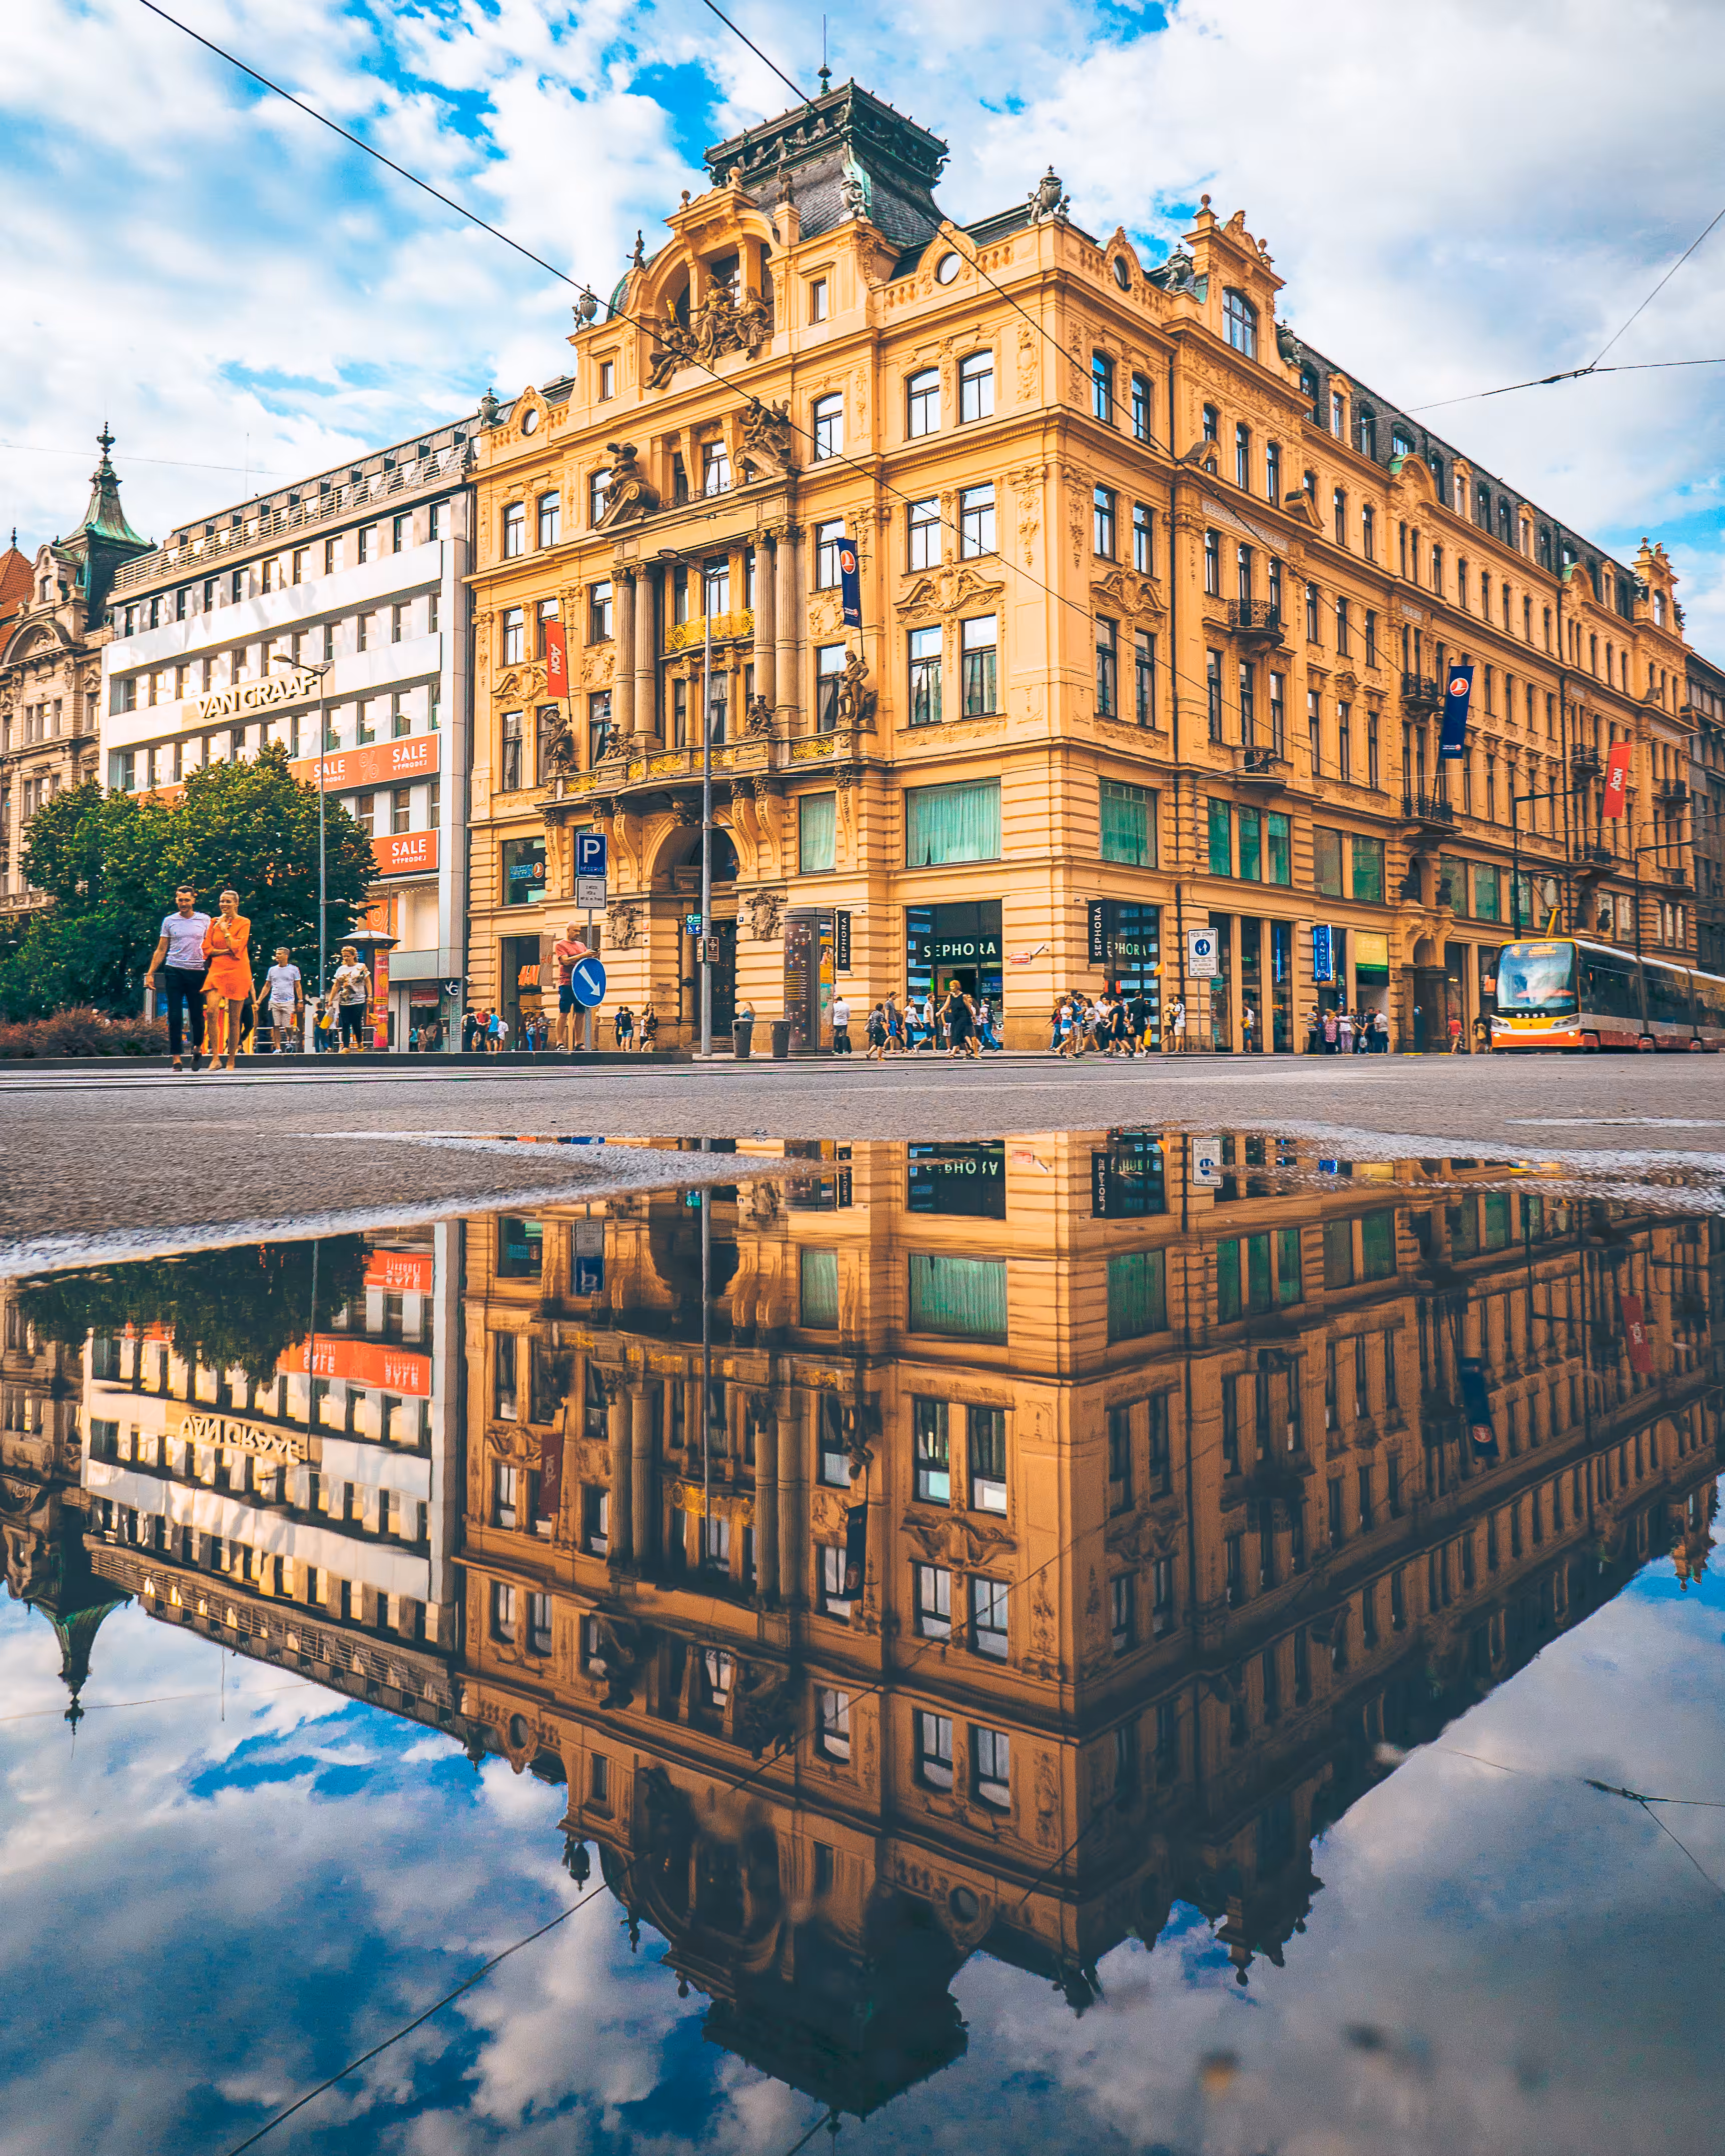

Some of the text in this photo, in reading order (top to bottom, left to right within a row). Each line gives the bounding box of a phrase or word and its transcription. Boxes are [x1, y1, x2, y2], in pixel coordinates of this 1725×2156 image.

[196, 670, 316, 718] VAN GRAAF
[392, 743, 427, 763] SALE
[314, 759, 345, 778] SALE
[392, 838, 426, 856] SALE
[584, 839, 600, 862] P
